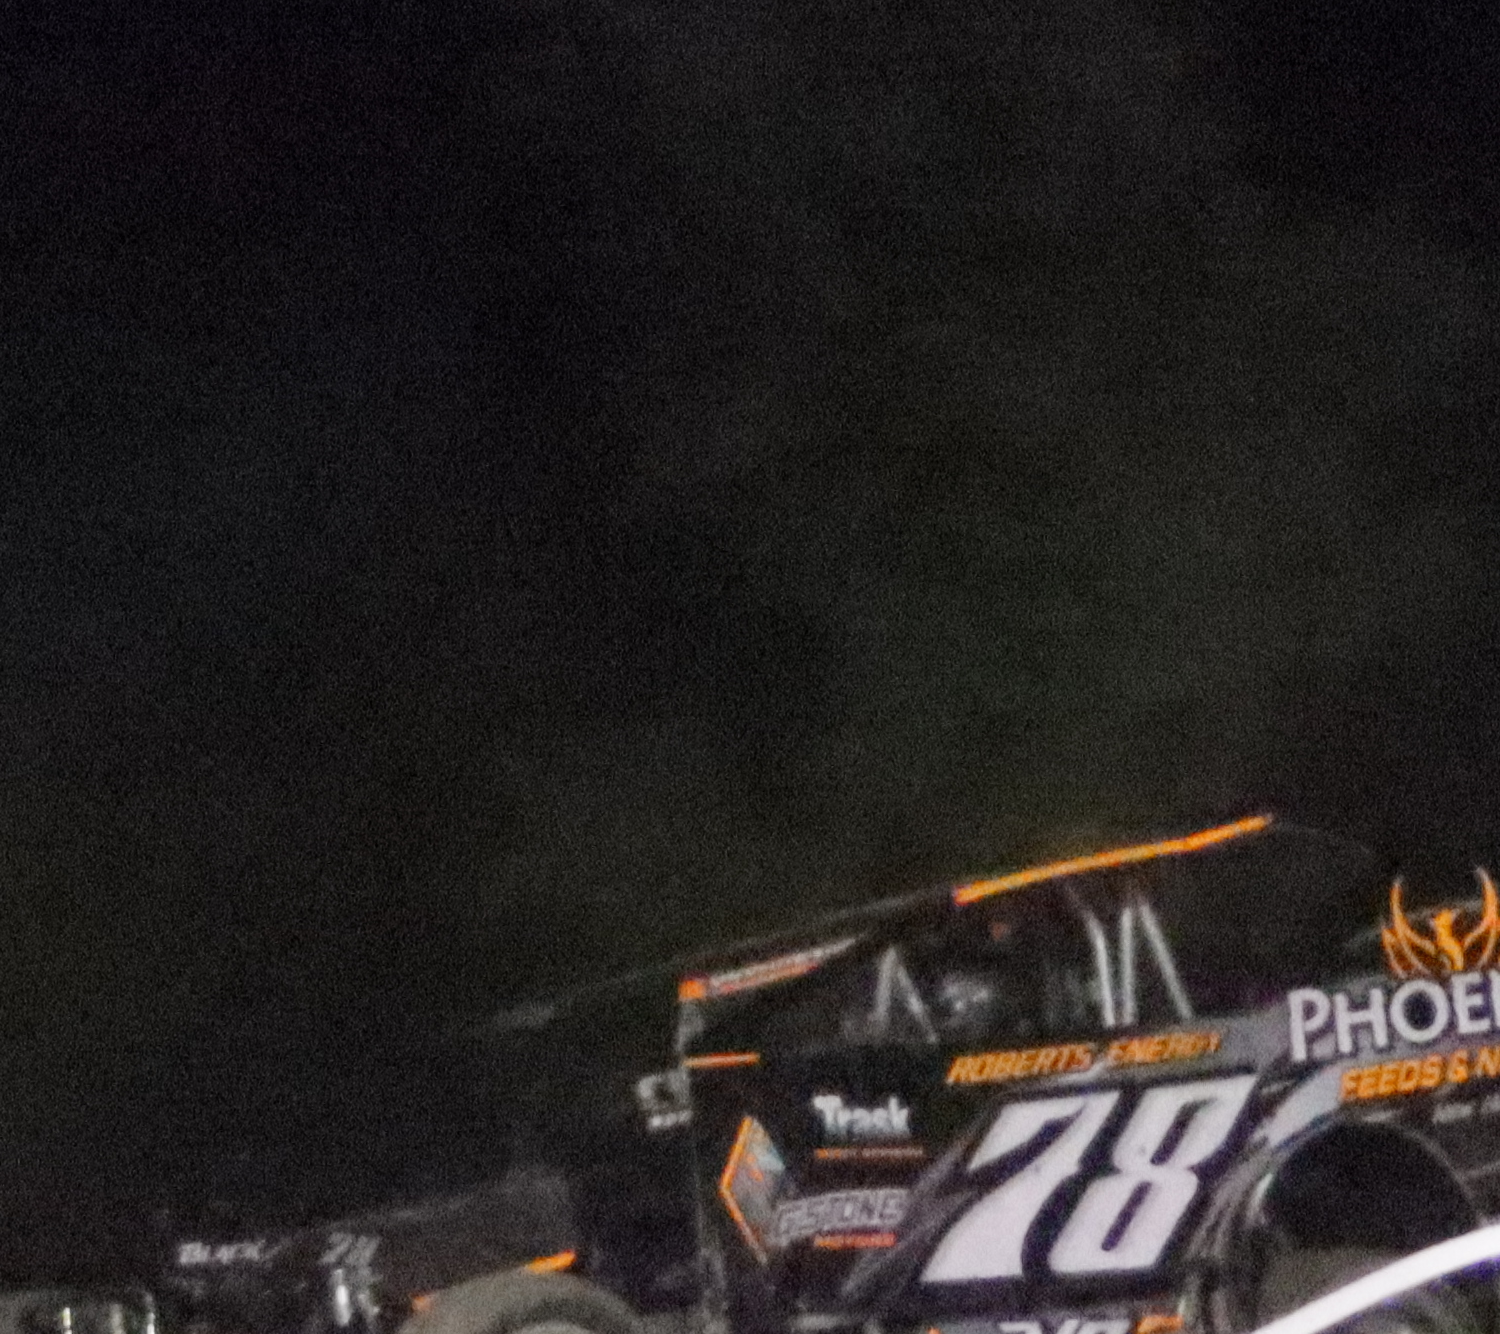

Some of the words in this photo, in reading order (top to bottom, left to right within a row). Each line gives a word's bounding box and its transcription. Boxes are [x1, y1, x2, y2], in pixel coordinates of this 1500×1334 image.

[945, 1043, 1096, 1085] ROBERTS
[1339, 1053, 1445, 1101] FEEDS
[1446, 1048, 1471, 1084] &
[921, 1075, 1262, 1284] 78
